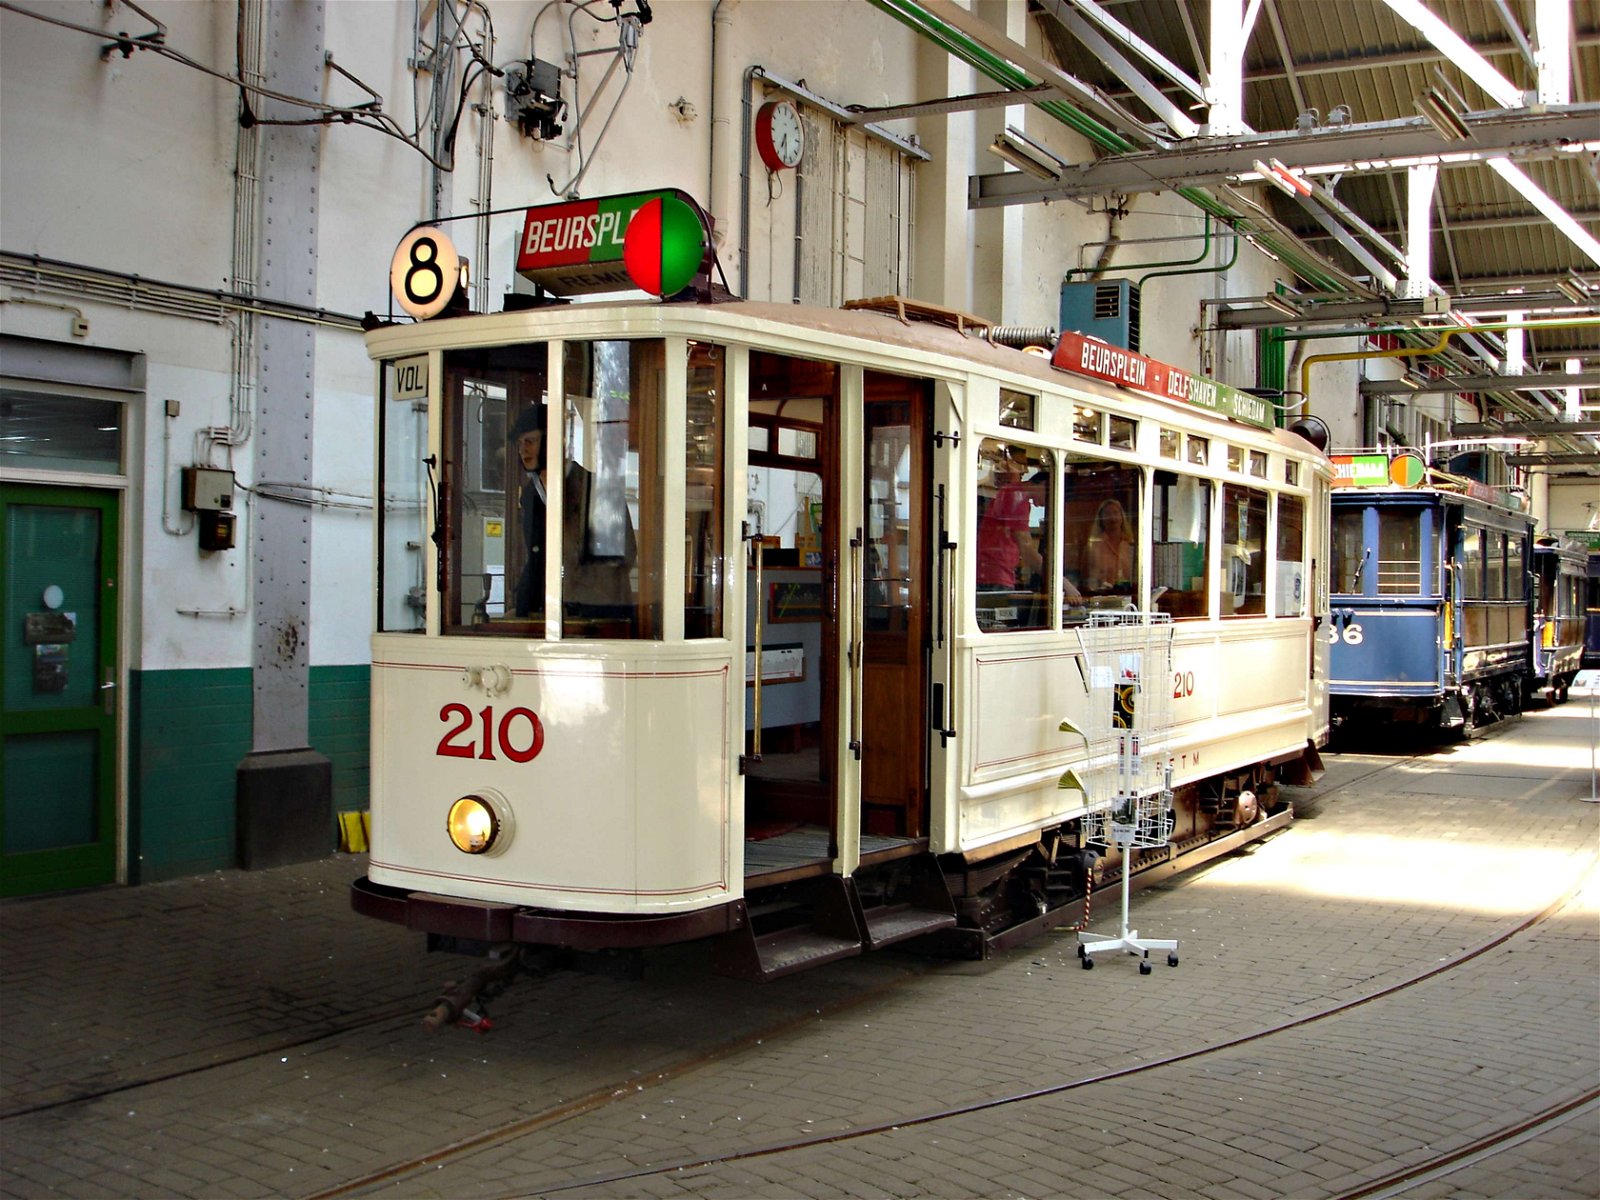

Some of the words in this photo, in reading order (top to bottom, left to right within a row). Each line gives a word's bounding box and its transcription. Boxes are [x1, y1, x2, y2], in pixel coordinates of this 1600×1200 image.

[525, 208, 639, 255] BEURSPL
[404, 236, 443, 306] 8
[558, 270, 628, 288] REMI
[397, 365, 424, 393] VOL
[1081, 342, 1146, 386] BEURSPLEIN
[1168, 370, 1217, 407] DELFSHAVEN
[1233, 393, 1265, 423] SCHIEDAM
[1173, 671, 1195, 699] 210
[436, 702, 545, 764] 210
